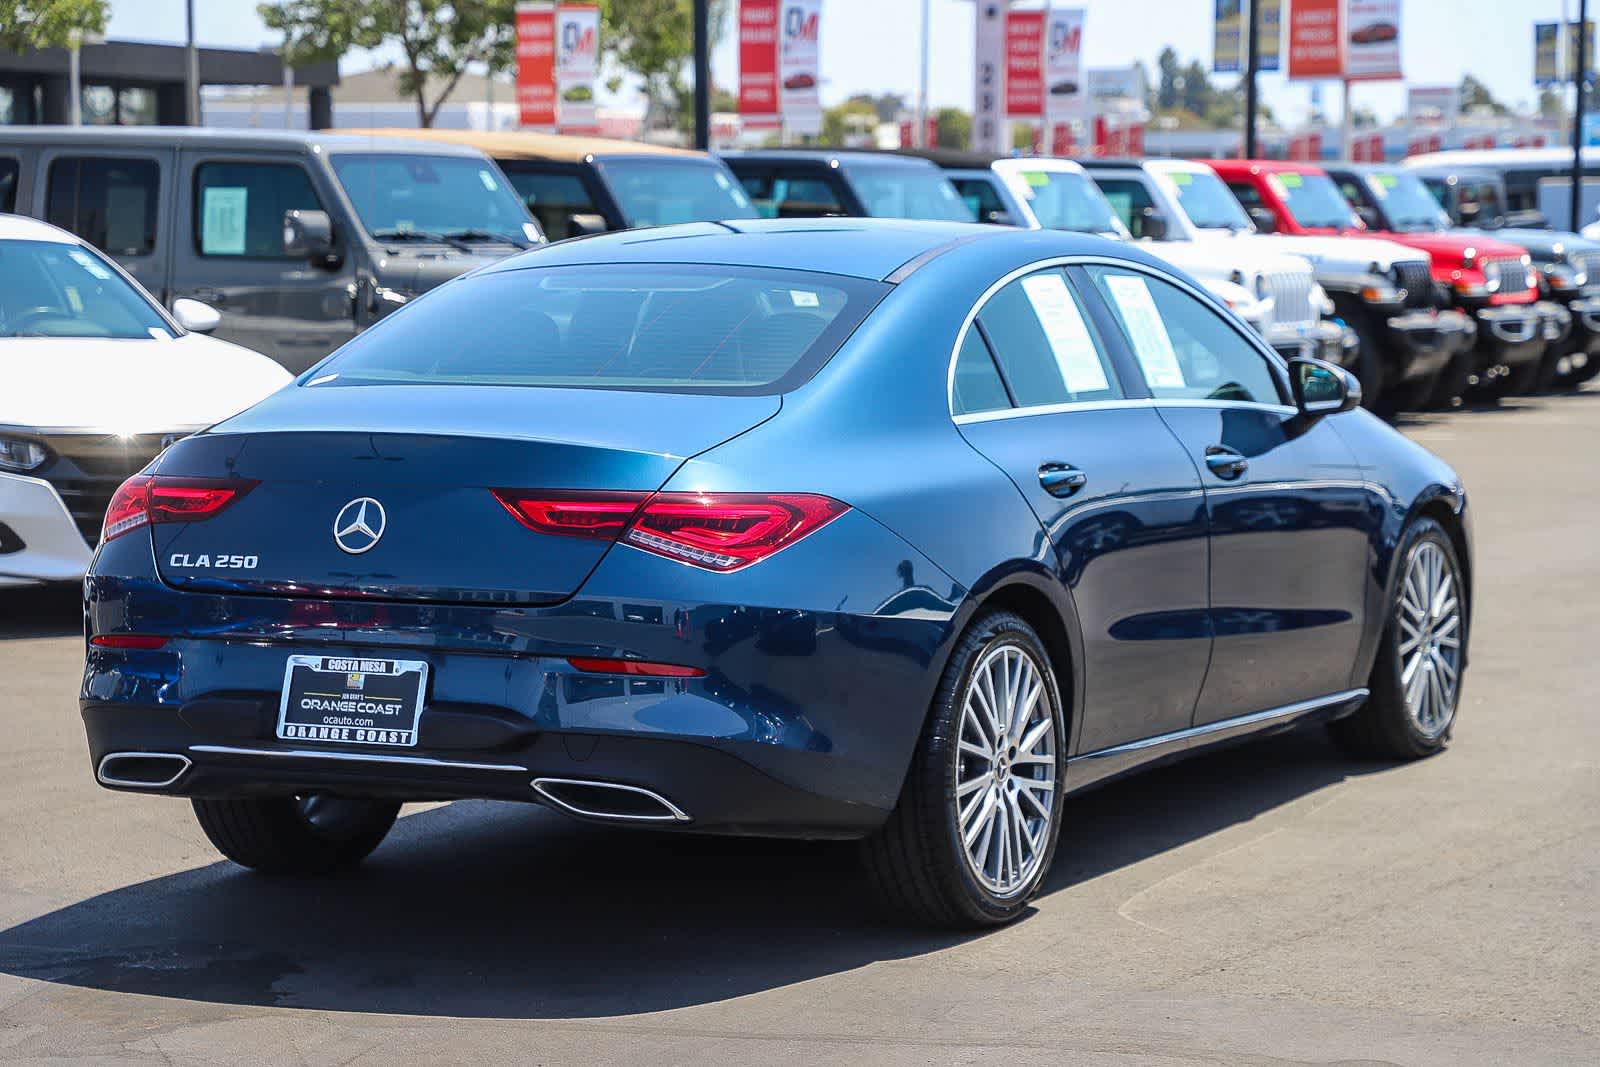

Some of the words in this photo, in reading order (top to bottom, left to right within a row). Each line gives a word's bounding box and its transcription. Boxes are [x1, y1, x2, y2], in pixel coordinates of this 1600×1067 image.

[170, 553, 210, 568] CLA
[214, 554, 259, 569] 250
[327, 658, 360, 672] COSTA
[360, 660, 386, 673] MESA
[322, 715, 374, 727] ocauto.com
[286, 725, 349, 740] ORANGE
[356, 730, 409, 744] COAST
